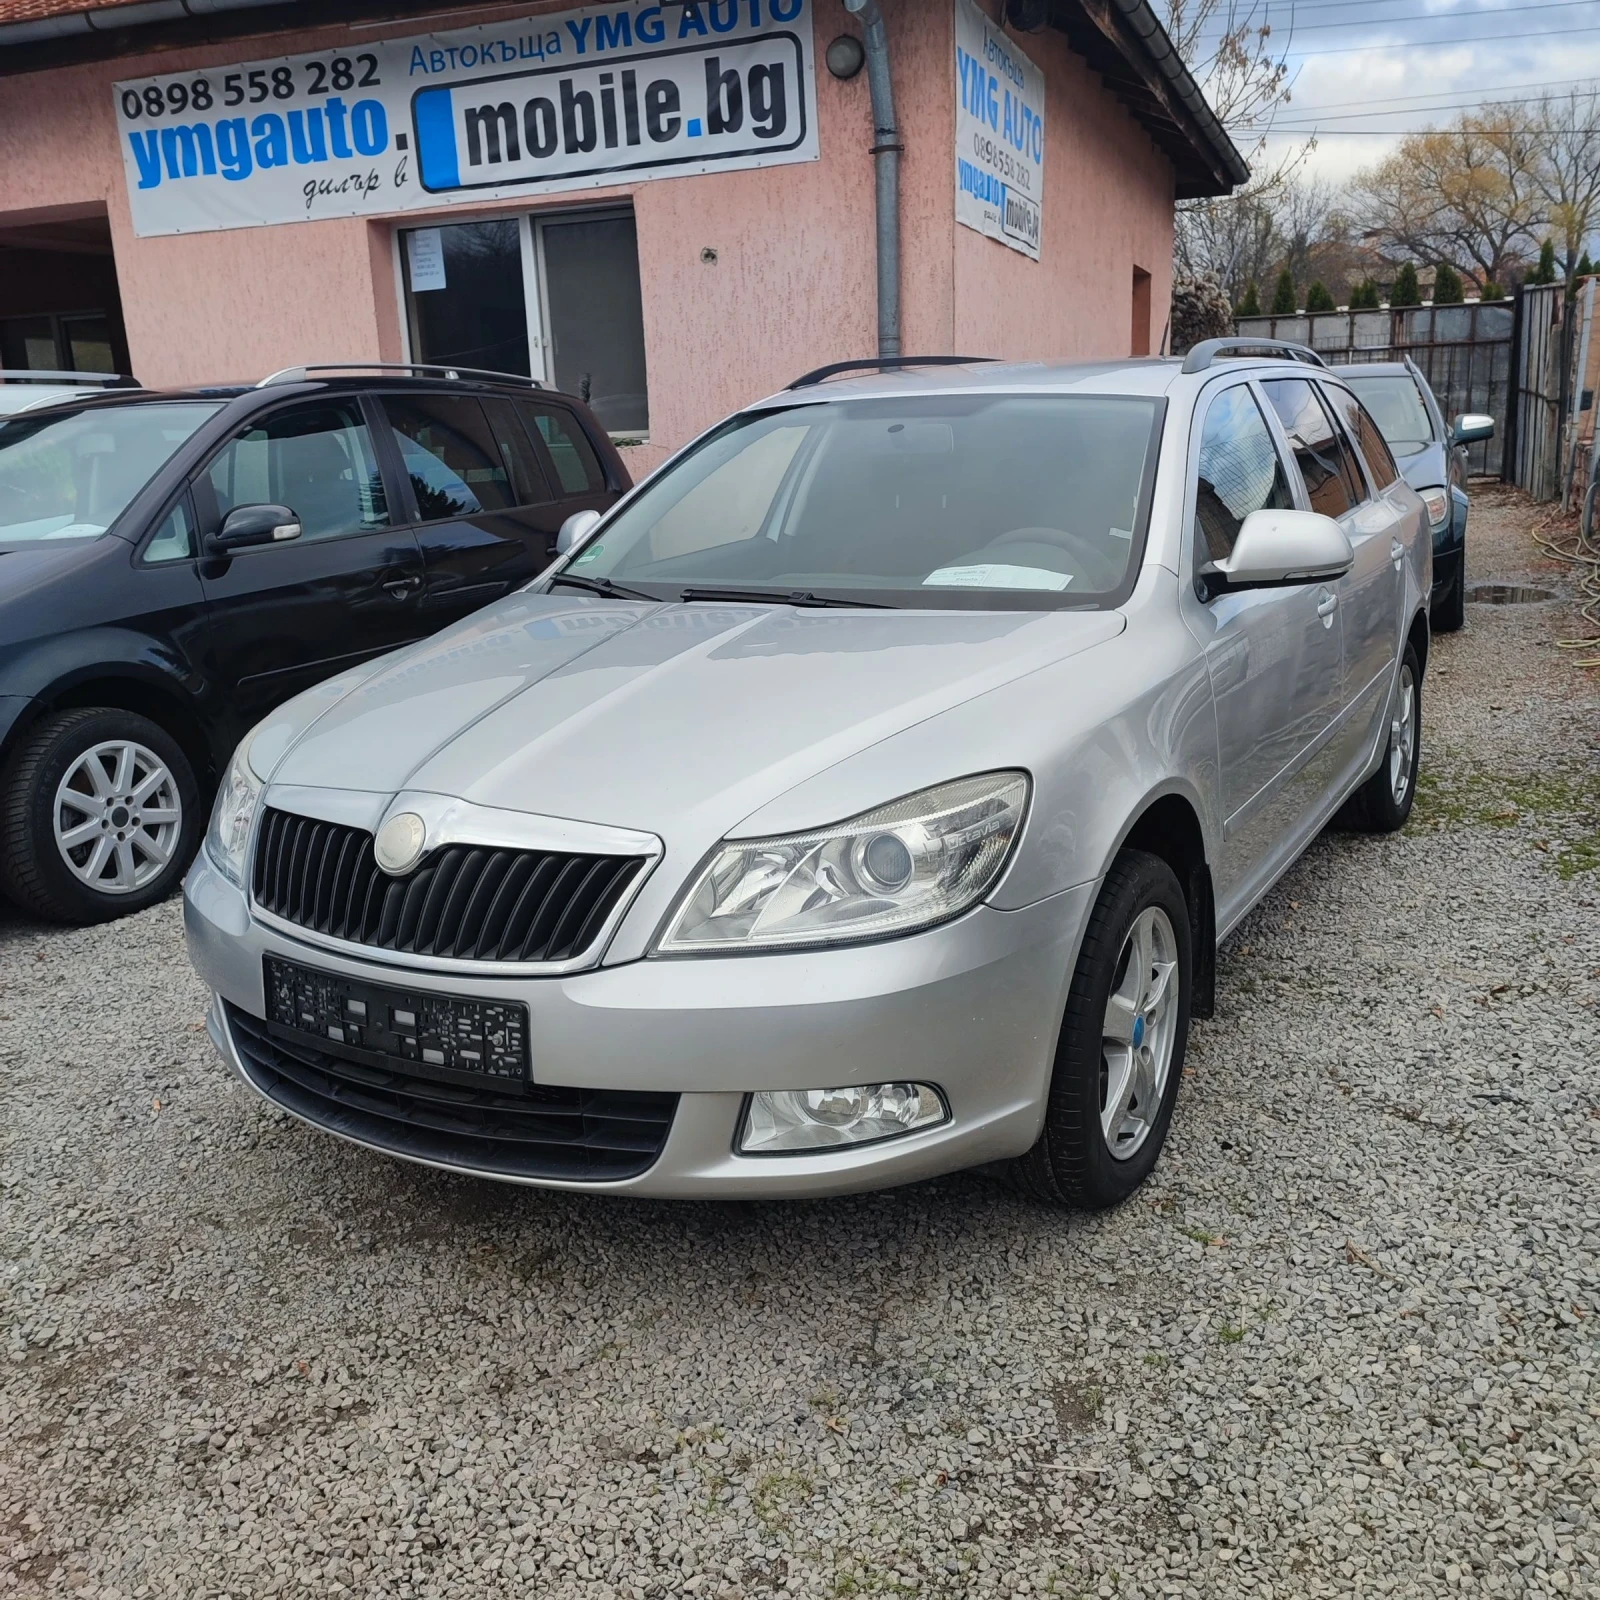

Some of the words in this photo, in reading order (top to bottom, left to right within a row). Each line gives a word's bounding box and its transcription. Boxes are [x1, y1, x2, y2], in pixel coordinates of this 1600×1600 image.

[409, 32, 562, 76] Автокъща
[566, 7, 667, 55] YMG
[121, 78, 214, 120] 0898
[224, 66, 295, 107] 558
[305, 53, 381, 96] 282
[464, 57, 787, 167] mobile.bg
[957, 45, 998, 133] YMG
[1003, 89, 1042, 165] AUTO
